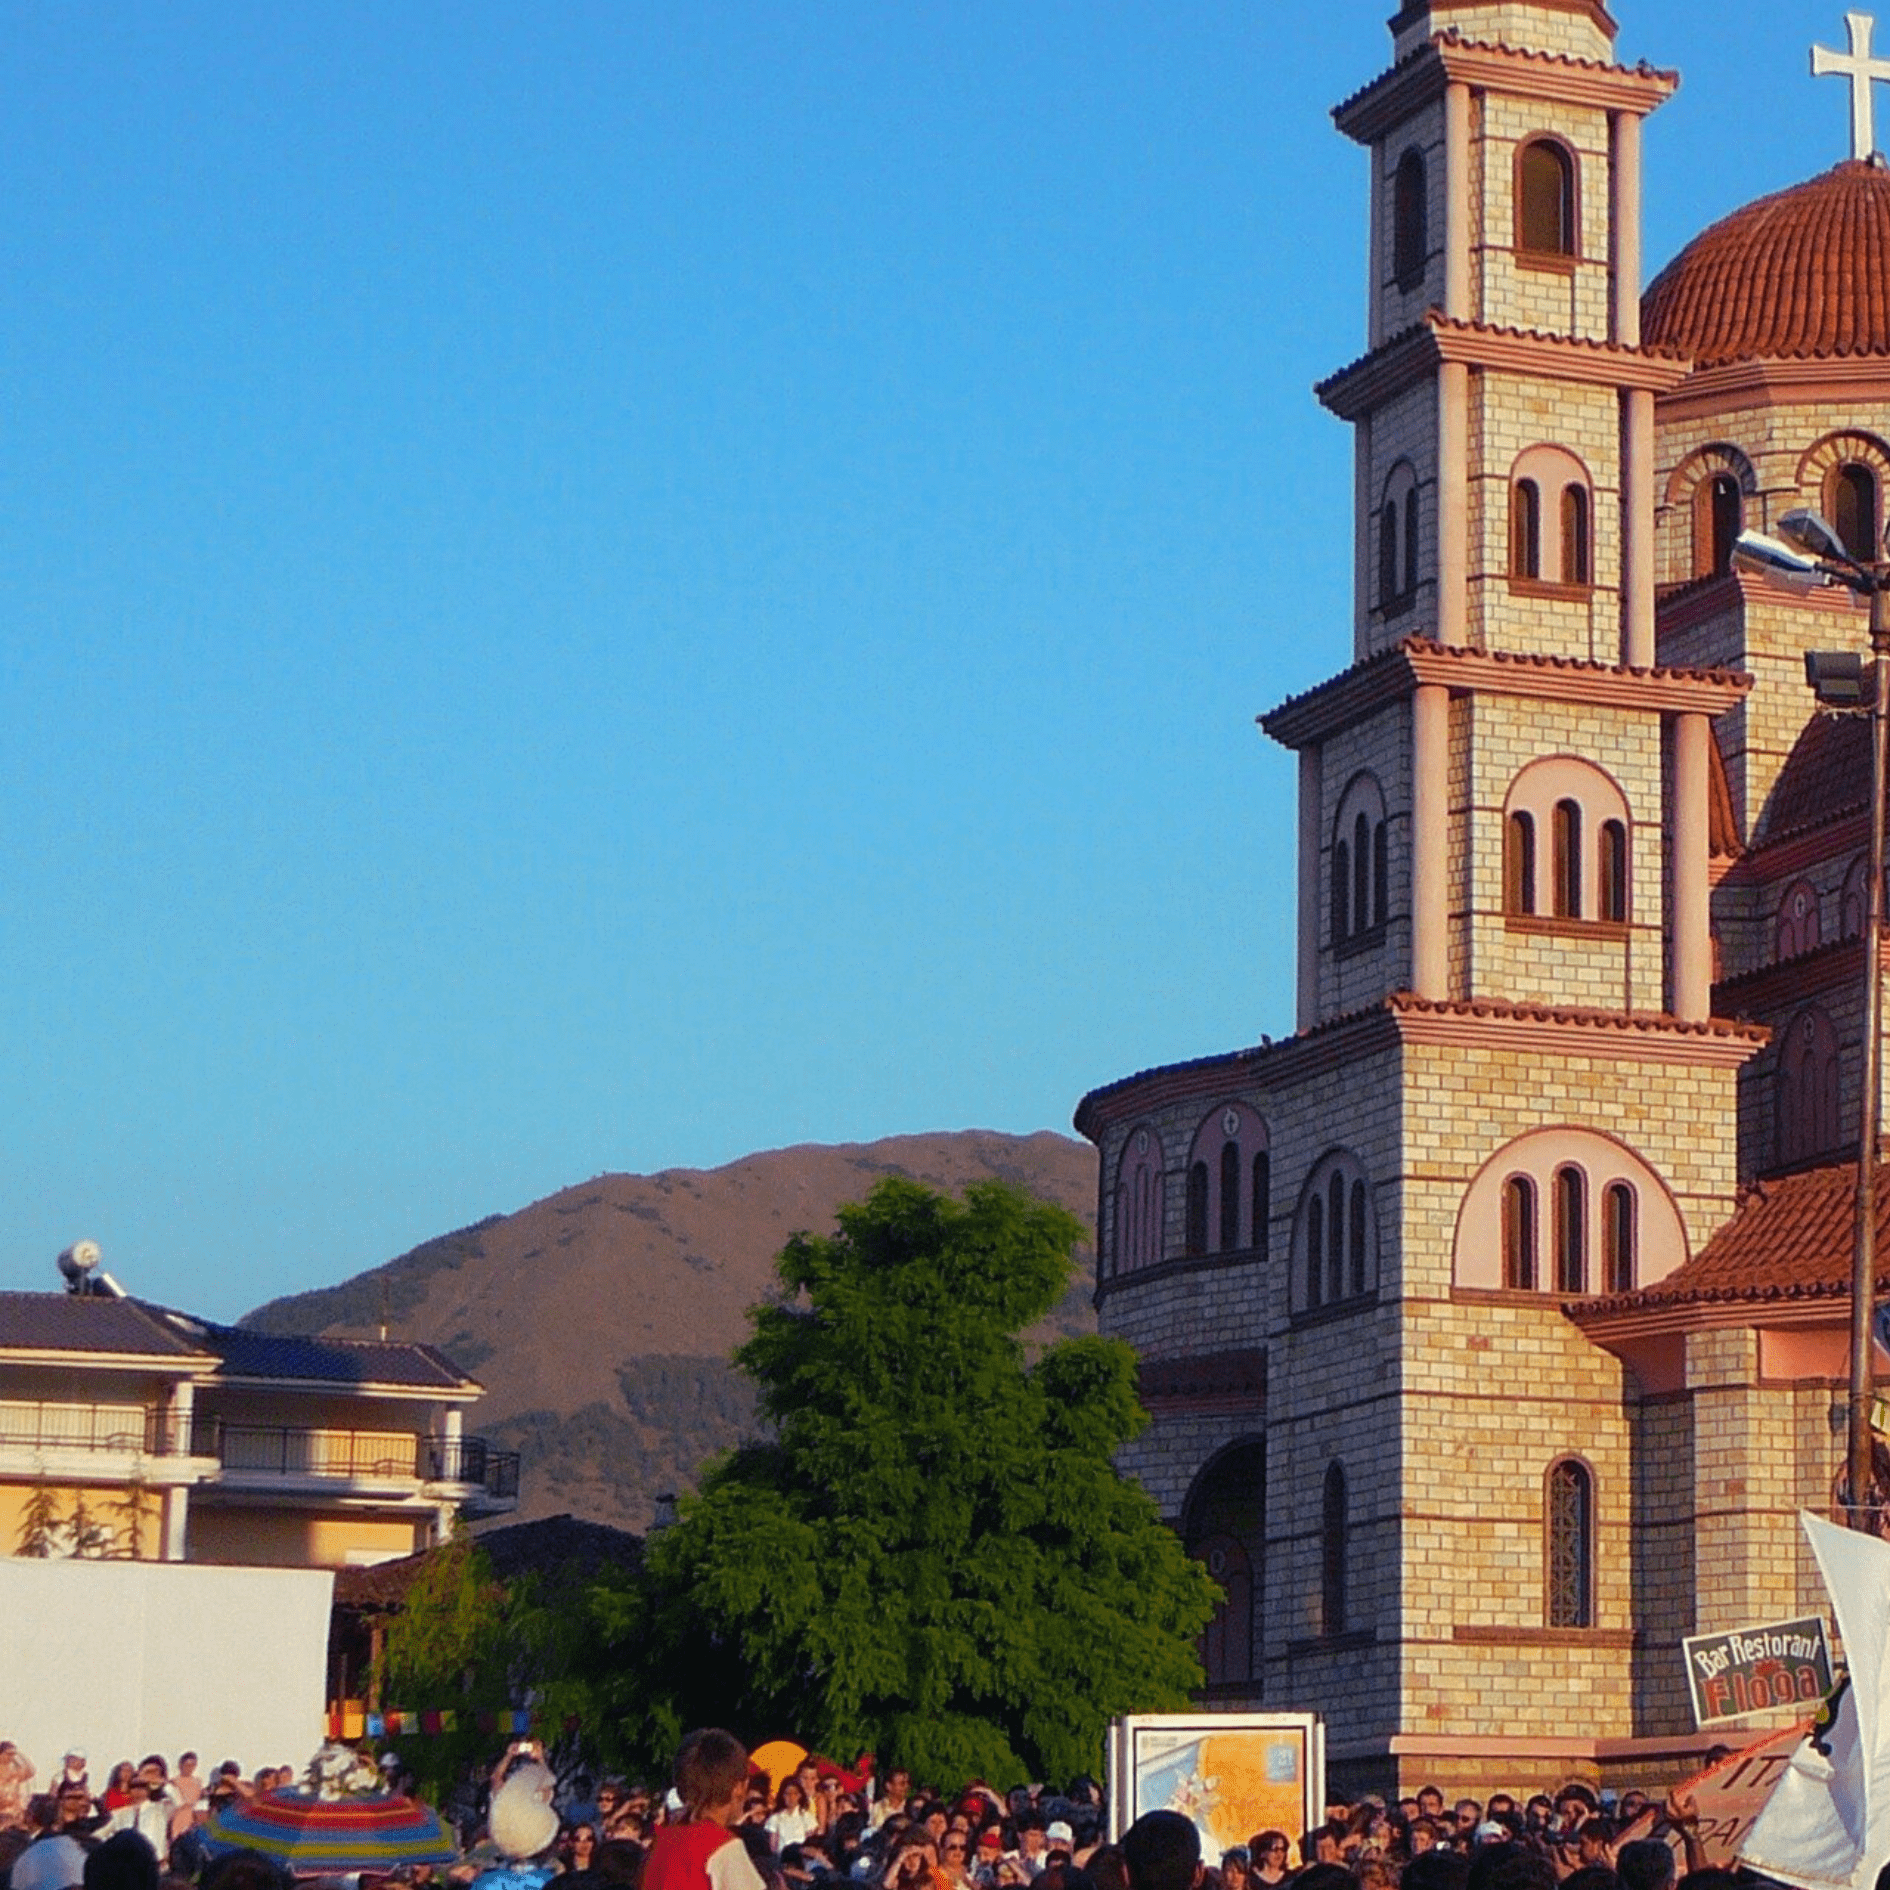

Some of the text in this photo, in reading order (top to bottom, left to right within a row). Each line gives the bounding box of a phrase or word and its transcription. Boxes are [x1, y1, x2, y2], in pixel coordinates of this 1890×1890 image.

[1694, 1632, 1822, 1678] Bar Restorant
[1701, 1665, 1819, 1718] Floga
